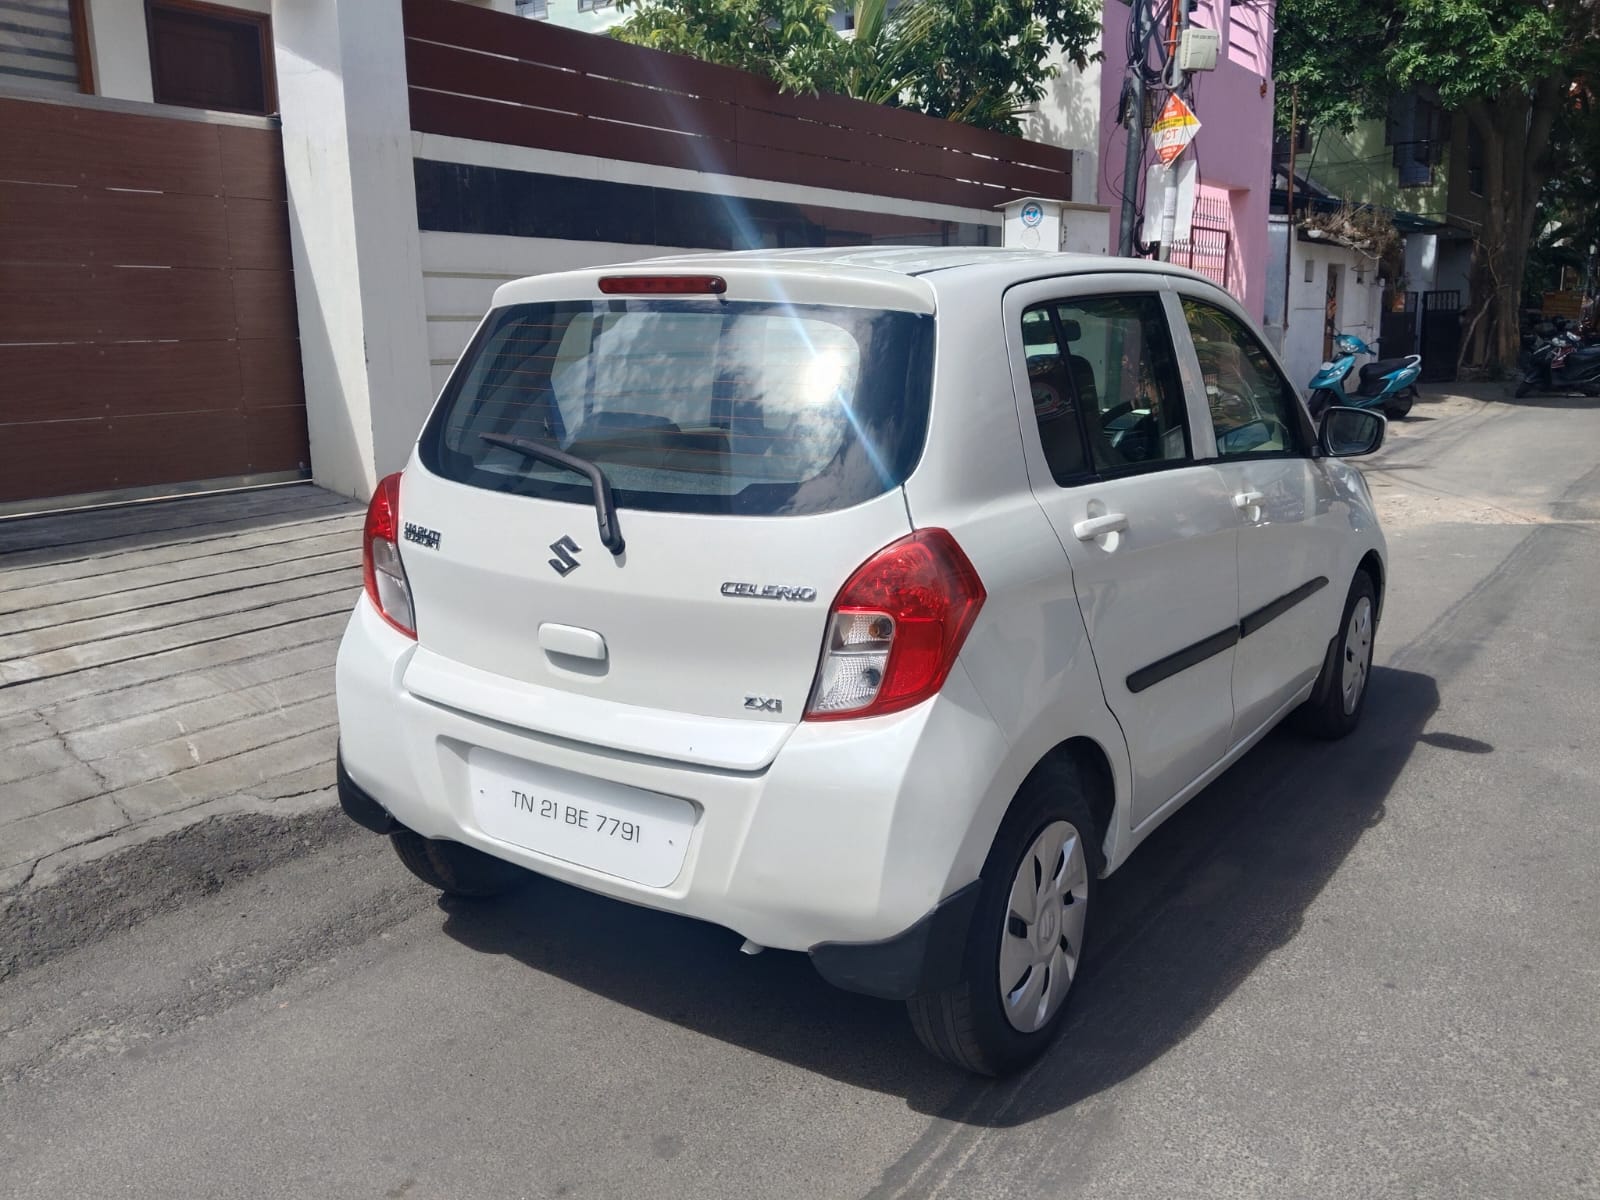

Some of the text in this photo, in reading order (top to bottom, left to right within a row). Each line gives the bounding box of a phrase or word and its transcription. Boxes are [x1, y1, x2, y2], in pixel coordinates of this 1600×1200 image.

[720, 581, 817, 602] CELERIO
[511, 790, 641, 844] TN 21 BE 7791
